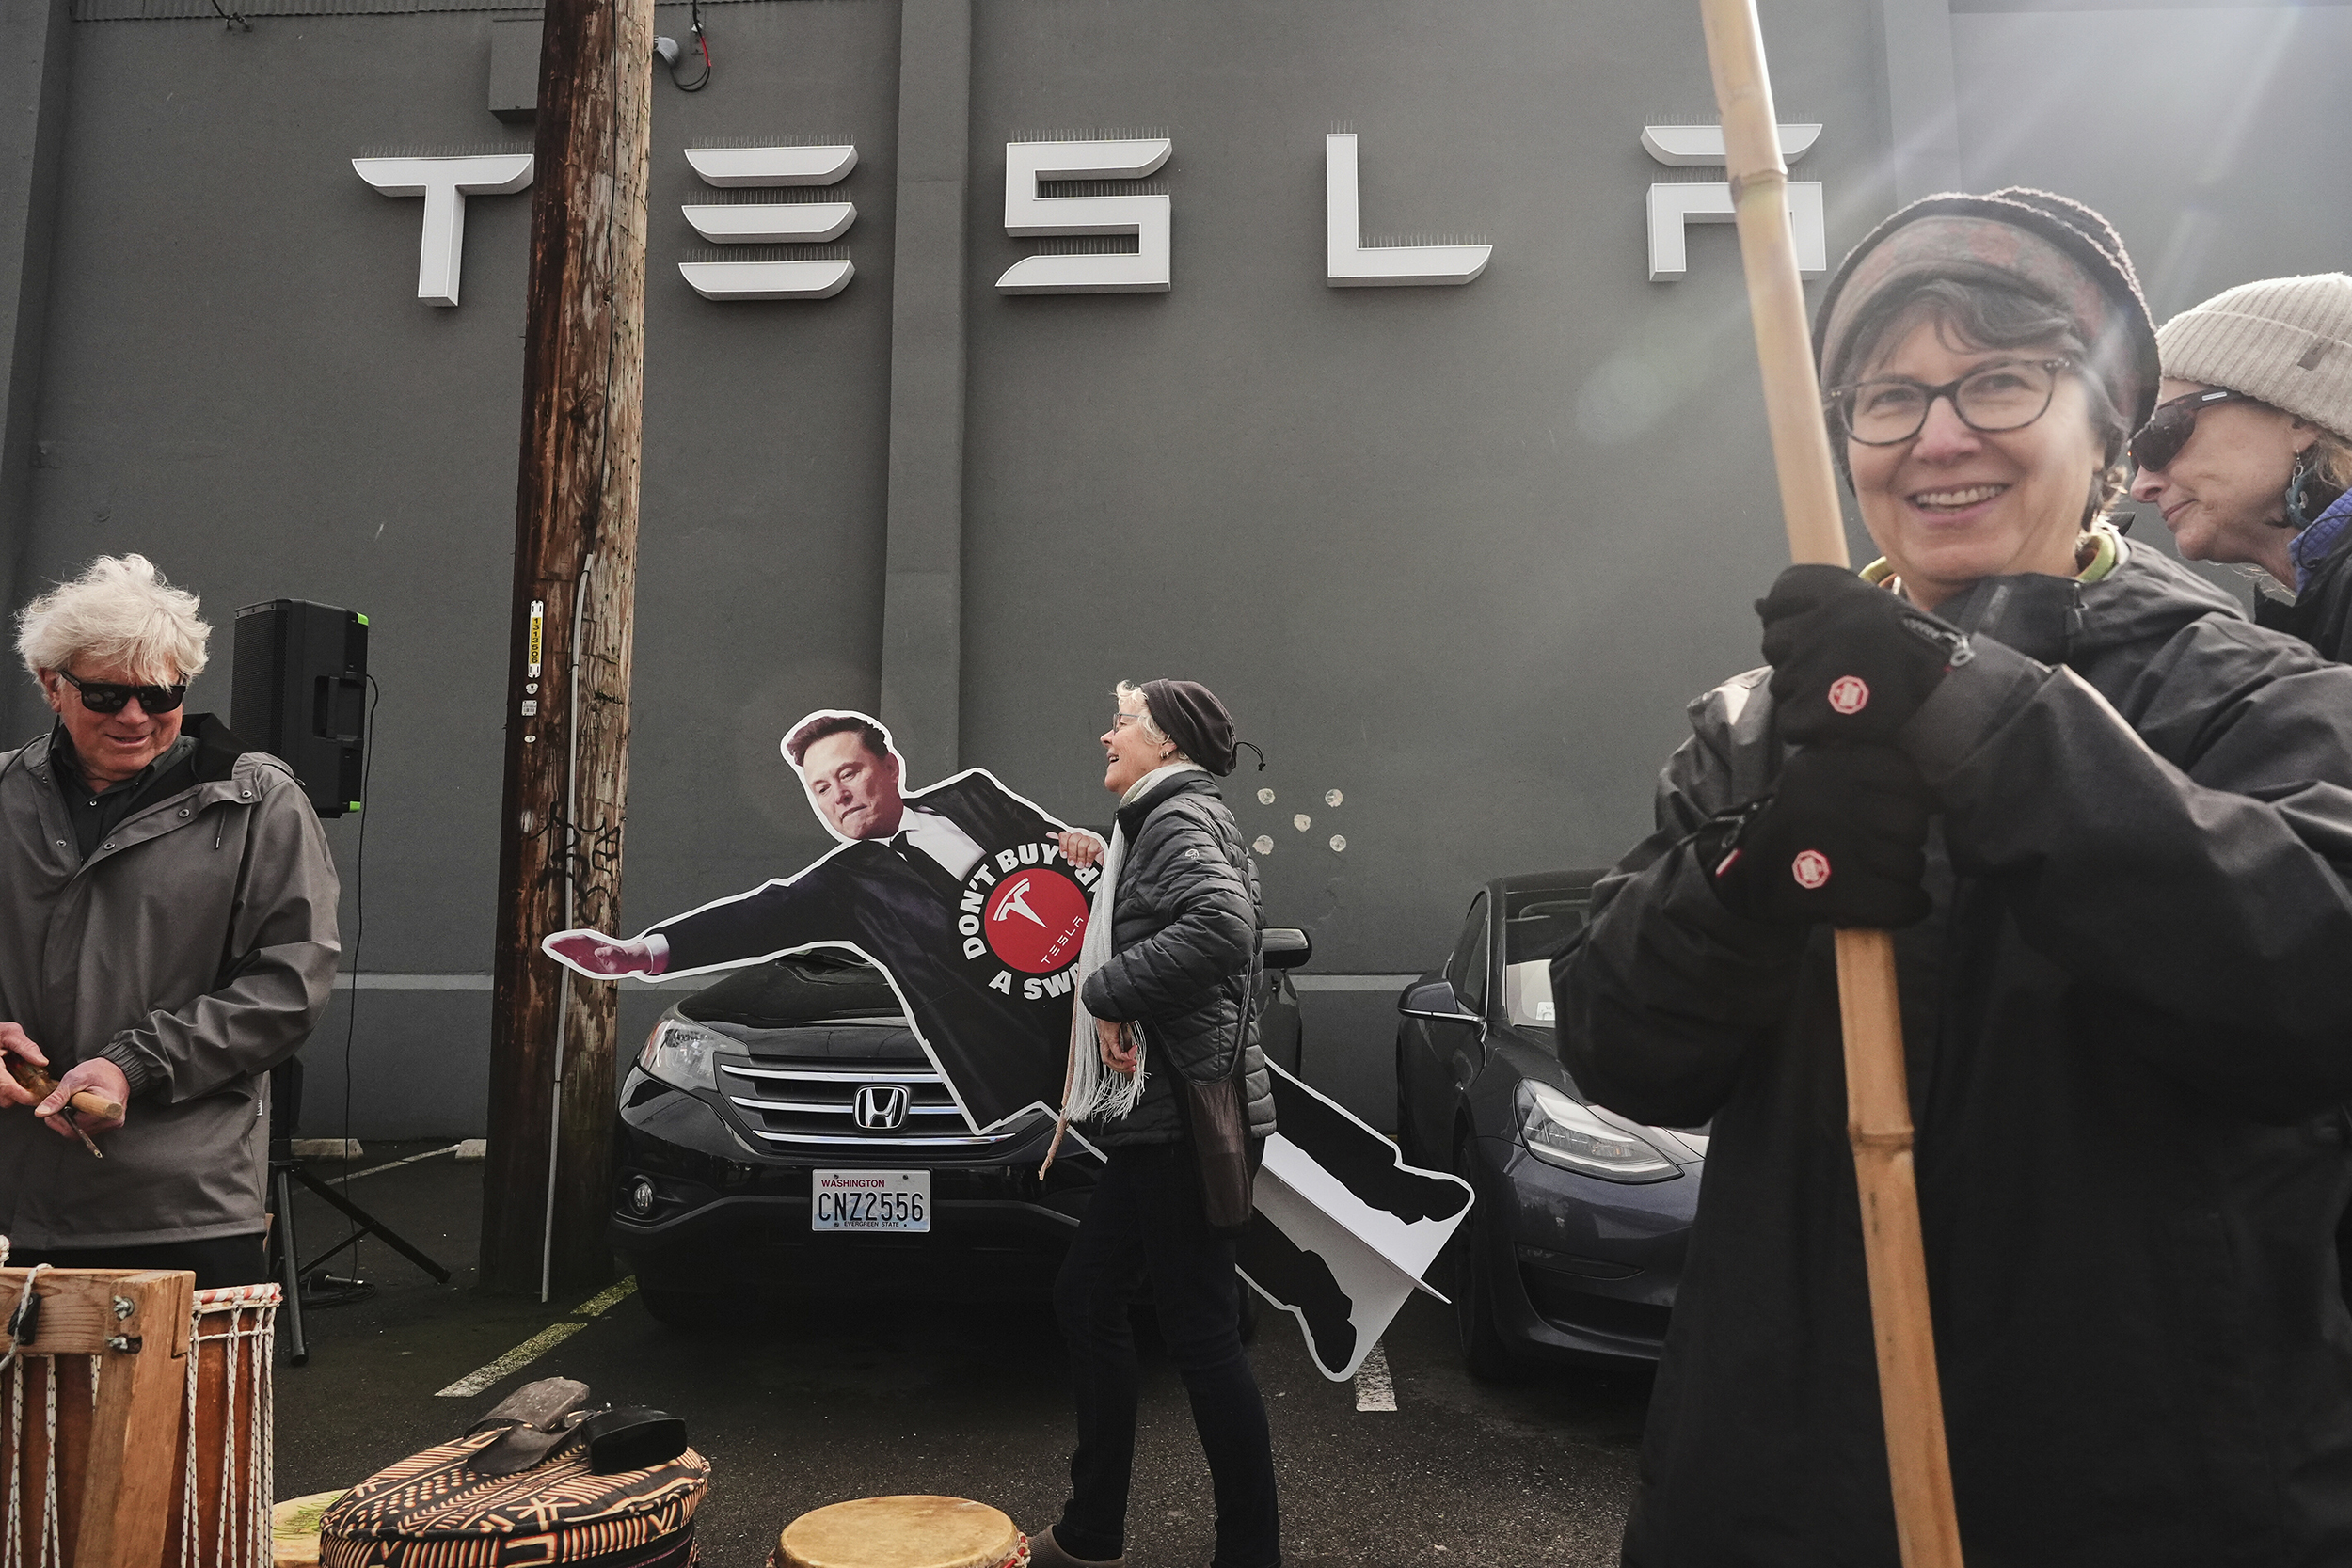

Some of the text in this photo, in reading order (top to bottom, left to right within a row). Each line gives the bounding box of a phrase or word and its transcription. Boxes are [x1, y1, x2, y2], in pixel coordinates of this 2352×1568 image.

[351, 123, 1825, 307] TESLA
[531, 618, 540, 663] 1313506
[958, 843, 1060, 960] DON'T BUY
[1040, 915, 1084, 964] TESLA
[988, 969, 1012, 996] A
[821, 1179, 885, 1188] WASHINGTON
[818, 1192, 924, 1222] CNZ2556
